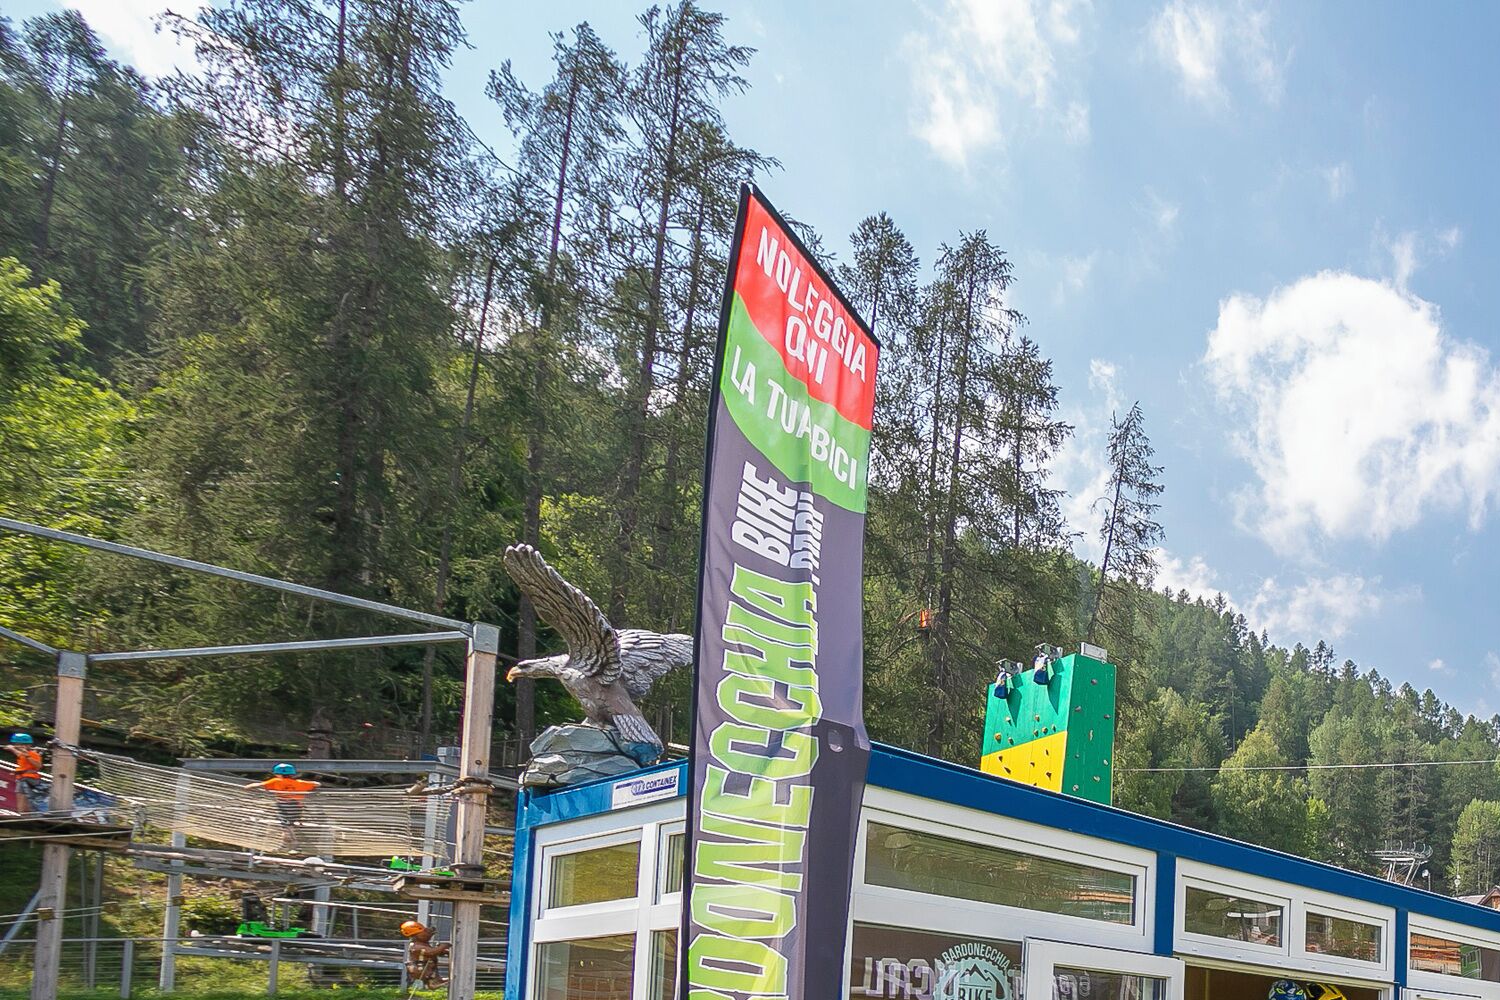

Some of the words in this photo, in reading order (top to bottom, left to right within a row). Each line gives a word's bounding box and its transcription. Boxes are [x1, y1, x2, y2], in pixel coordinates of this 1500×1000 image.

[756, 225, 866, 383] NOLEGGIA
[785, 316, 830, 385] QUI
[730, 345, 756, 406] LA
[767, 379, 813, 442] TUA
[809, 413, 858, 490] BICI
[731, 460, 798, 567] BIKE
[942, 943, 1010, 971] BARDONECCHIA
